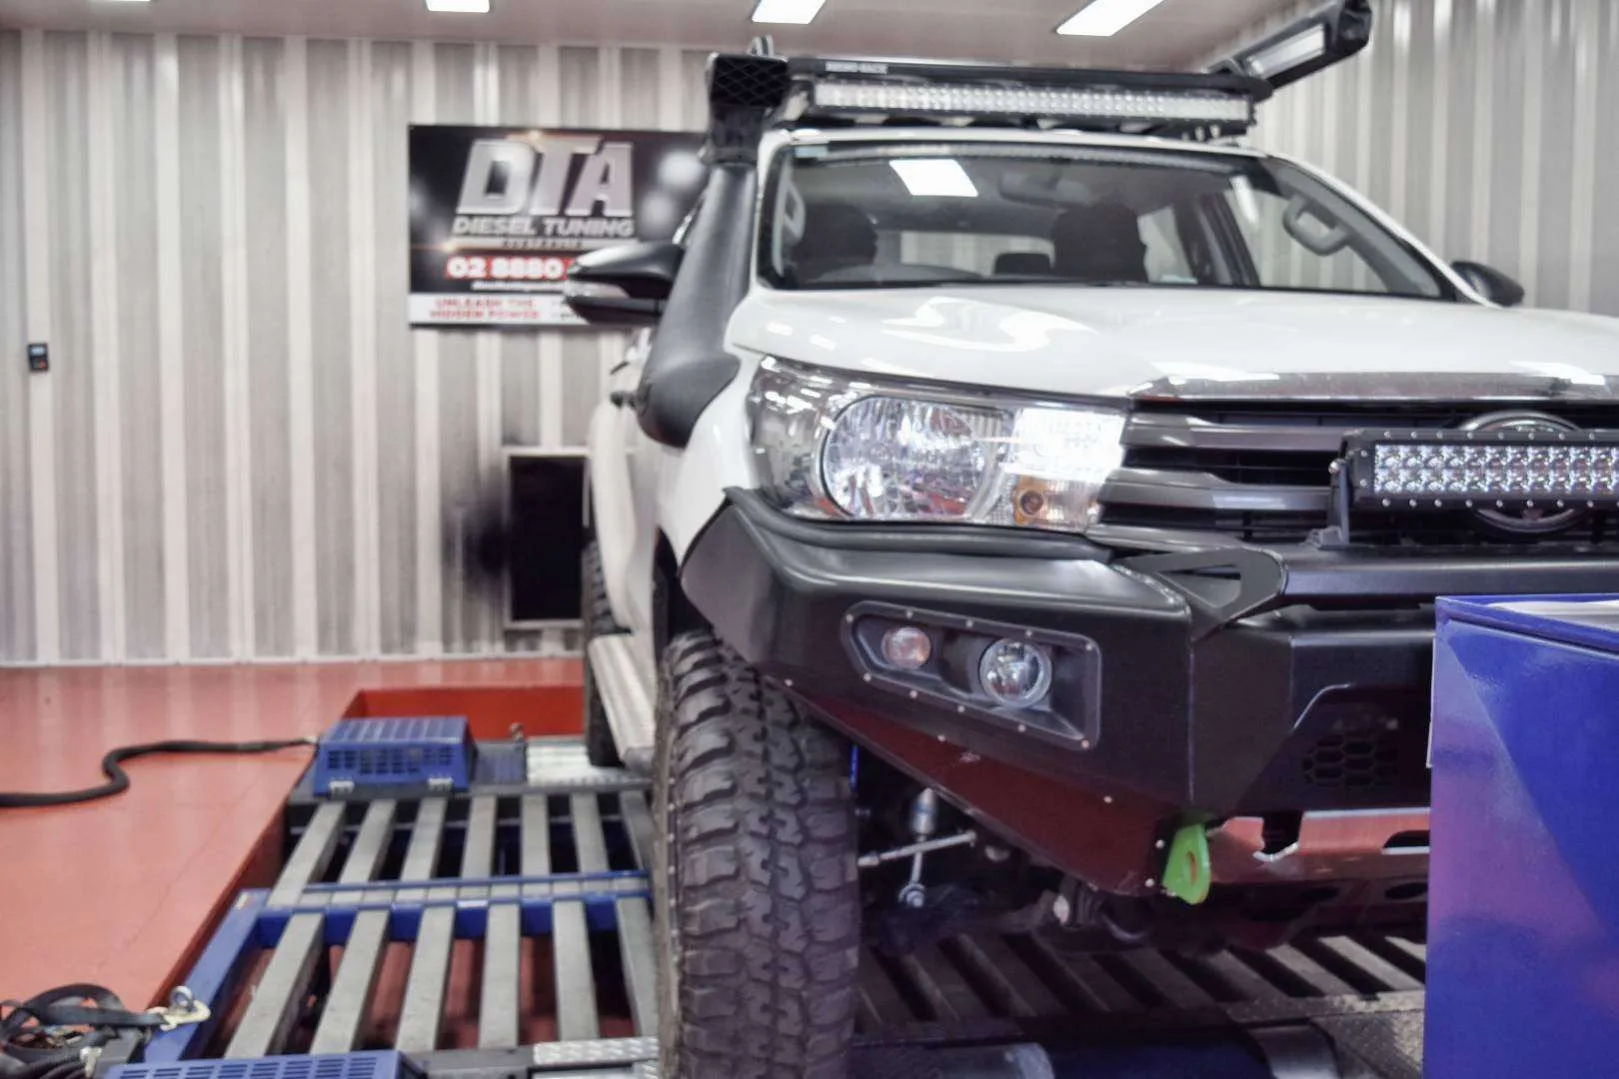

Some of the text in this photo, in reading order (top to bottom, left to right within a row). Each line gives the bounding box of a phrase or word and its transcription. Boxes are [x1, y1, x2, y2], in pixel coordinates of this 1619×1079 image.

[456, 134, 634, 216] DTA
[453, 217, 634, 237] DIESEL TUNING
[447, 257, 486, 279] 02
